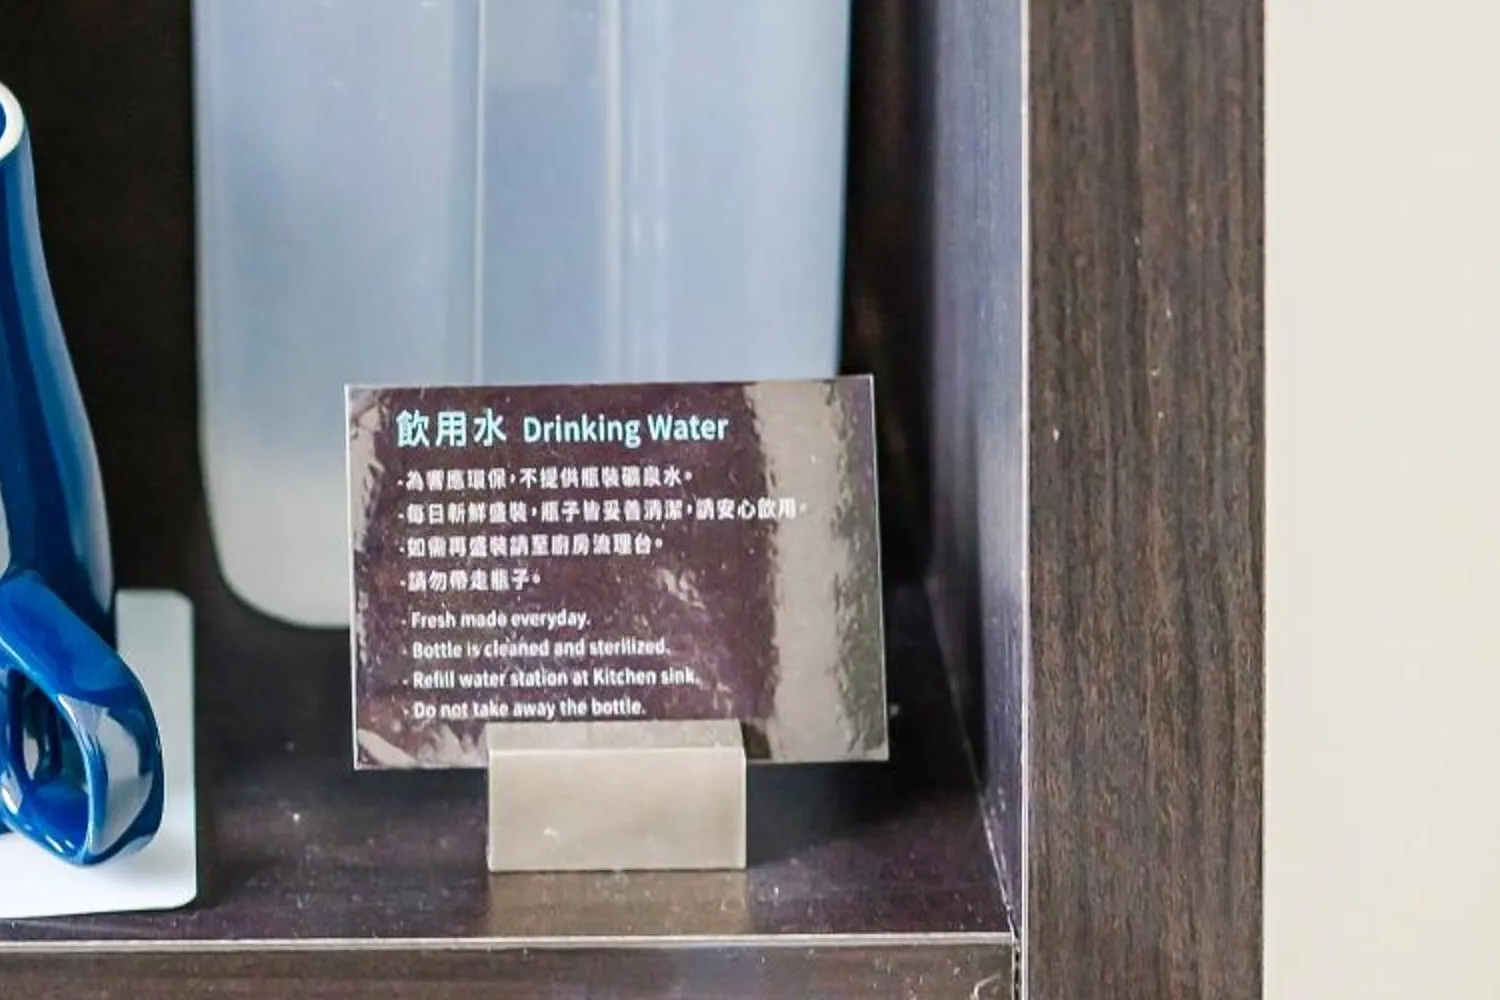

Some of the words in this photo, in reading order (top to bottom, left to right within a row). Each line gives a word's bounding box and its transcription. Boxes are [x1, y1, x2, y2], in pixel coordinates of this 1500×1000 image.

[395, 408, 507, 447] 飲用水
[523, 414, 642, 449] Drinking
[647, 413, 729, 441] Water
[411, 610, 457, 629] Fresh
[460, 609, 508, 628] made
[510, 608, 591, 631] everyday.
[412, 640, 463, 659] Bottle
[466, 640, 481, 657] is
[483, 639, 550, 658] cleaned
[553, 638, 586, 658] and
[588, 636, 671, 657] sterilized.
[413, 670, 455, 689] Refill
[458, 669, 507, 688] water
[509, 669, 569, 688] station
[572, 669, 589, 687] at
[593, 667, 657, 687] Kitchen
[660, 666, 701, 686] sink.
[412, 701, 437, 719] Do
[439, 701, 469, 719] not
[471, 699, 510, 718] take
[512, 701, 556, 720] away
[559, 698, 588, 716] the
[591, 697, 647, 717] bottle.
